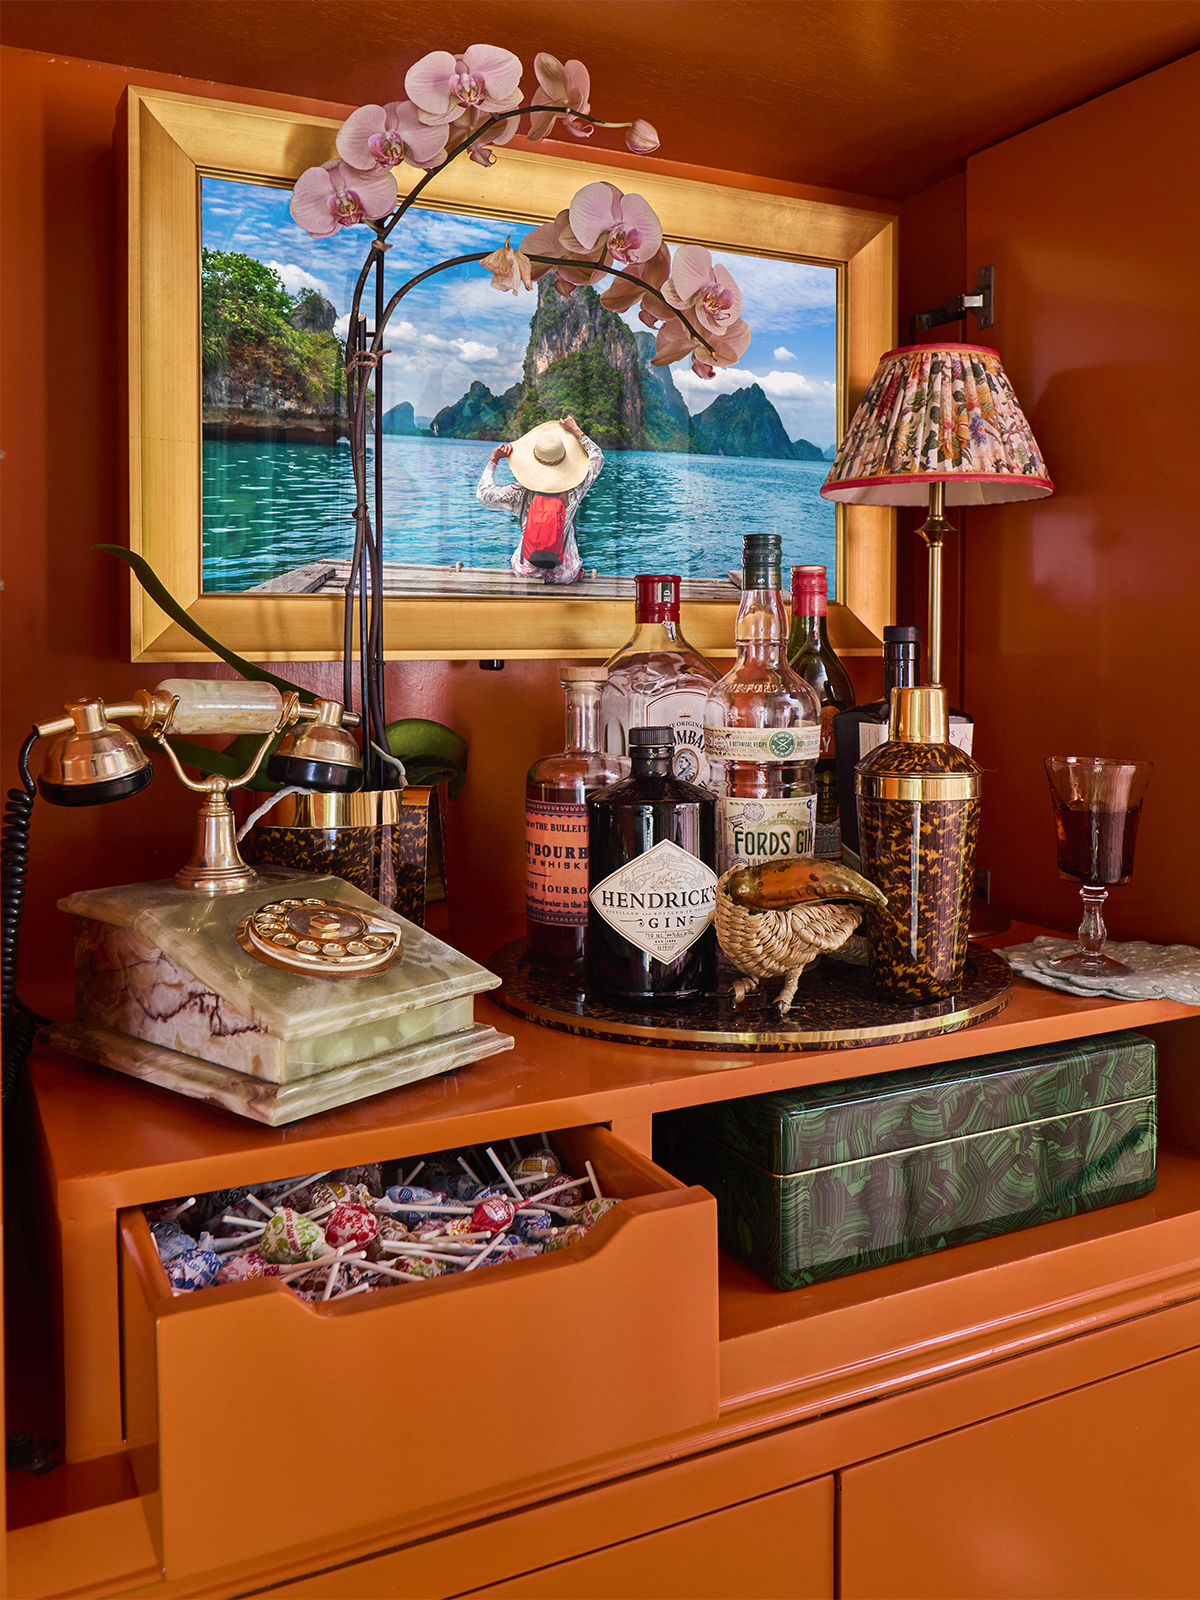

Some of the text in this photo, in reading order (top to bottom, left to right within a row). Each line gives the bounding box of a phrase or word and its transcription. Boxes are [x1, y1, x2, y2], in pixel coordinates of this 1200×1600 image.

[676, 720, 704, 729] ORIGINA
[673, 730, 705, 753] MBA
[536, 821, 548, 830] THE
[550, 824, 586, 832] BULLEIT
[734, 832, 790, 856] FORDS
[795, 830, 813, 854] GIN
[534, 844, 588, 859] BOURB
[540, 860, 588, 870] WHISKE
[542, 884, 587, 894] BOURBO
[601, 884, 717, 908] HENDRICK'S
[648, 916, 686, 928] GIN
